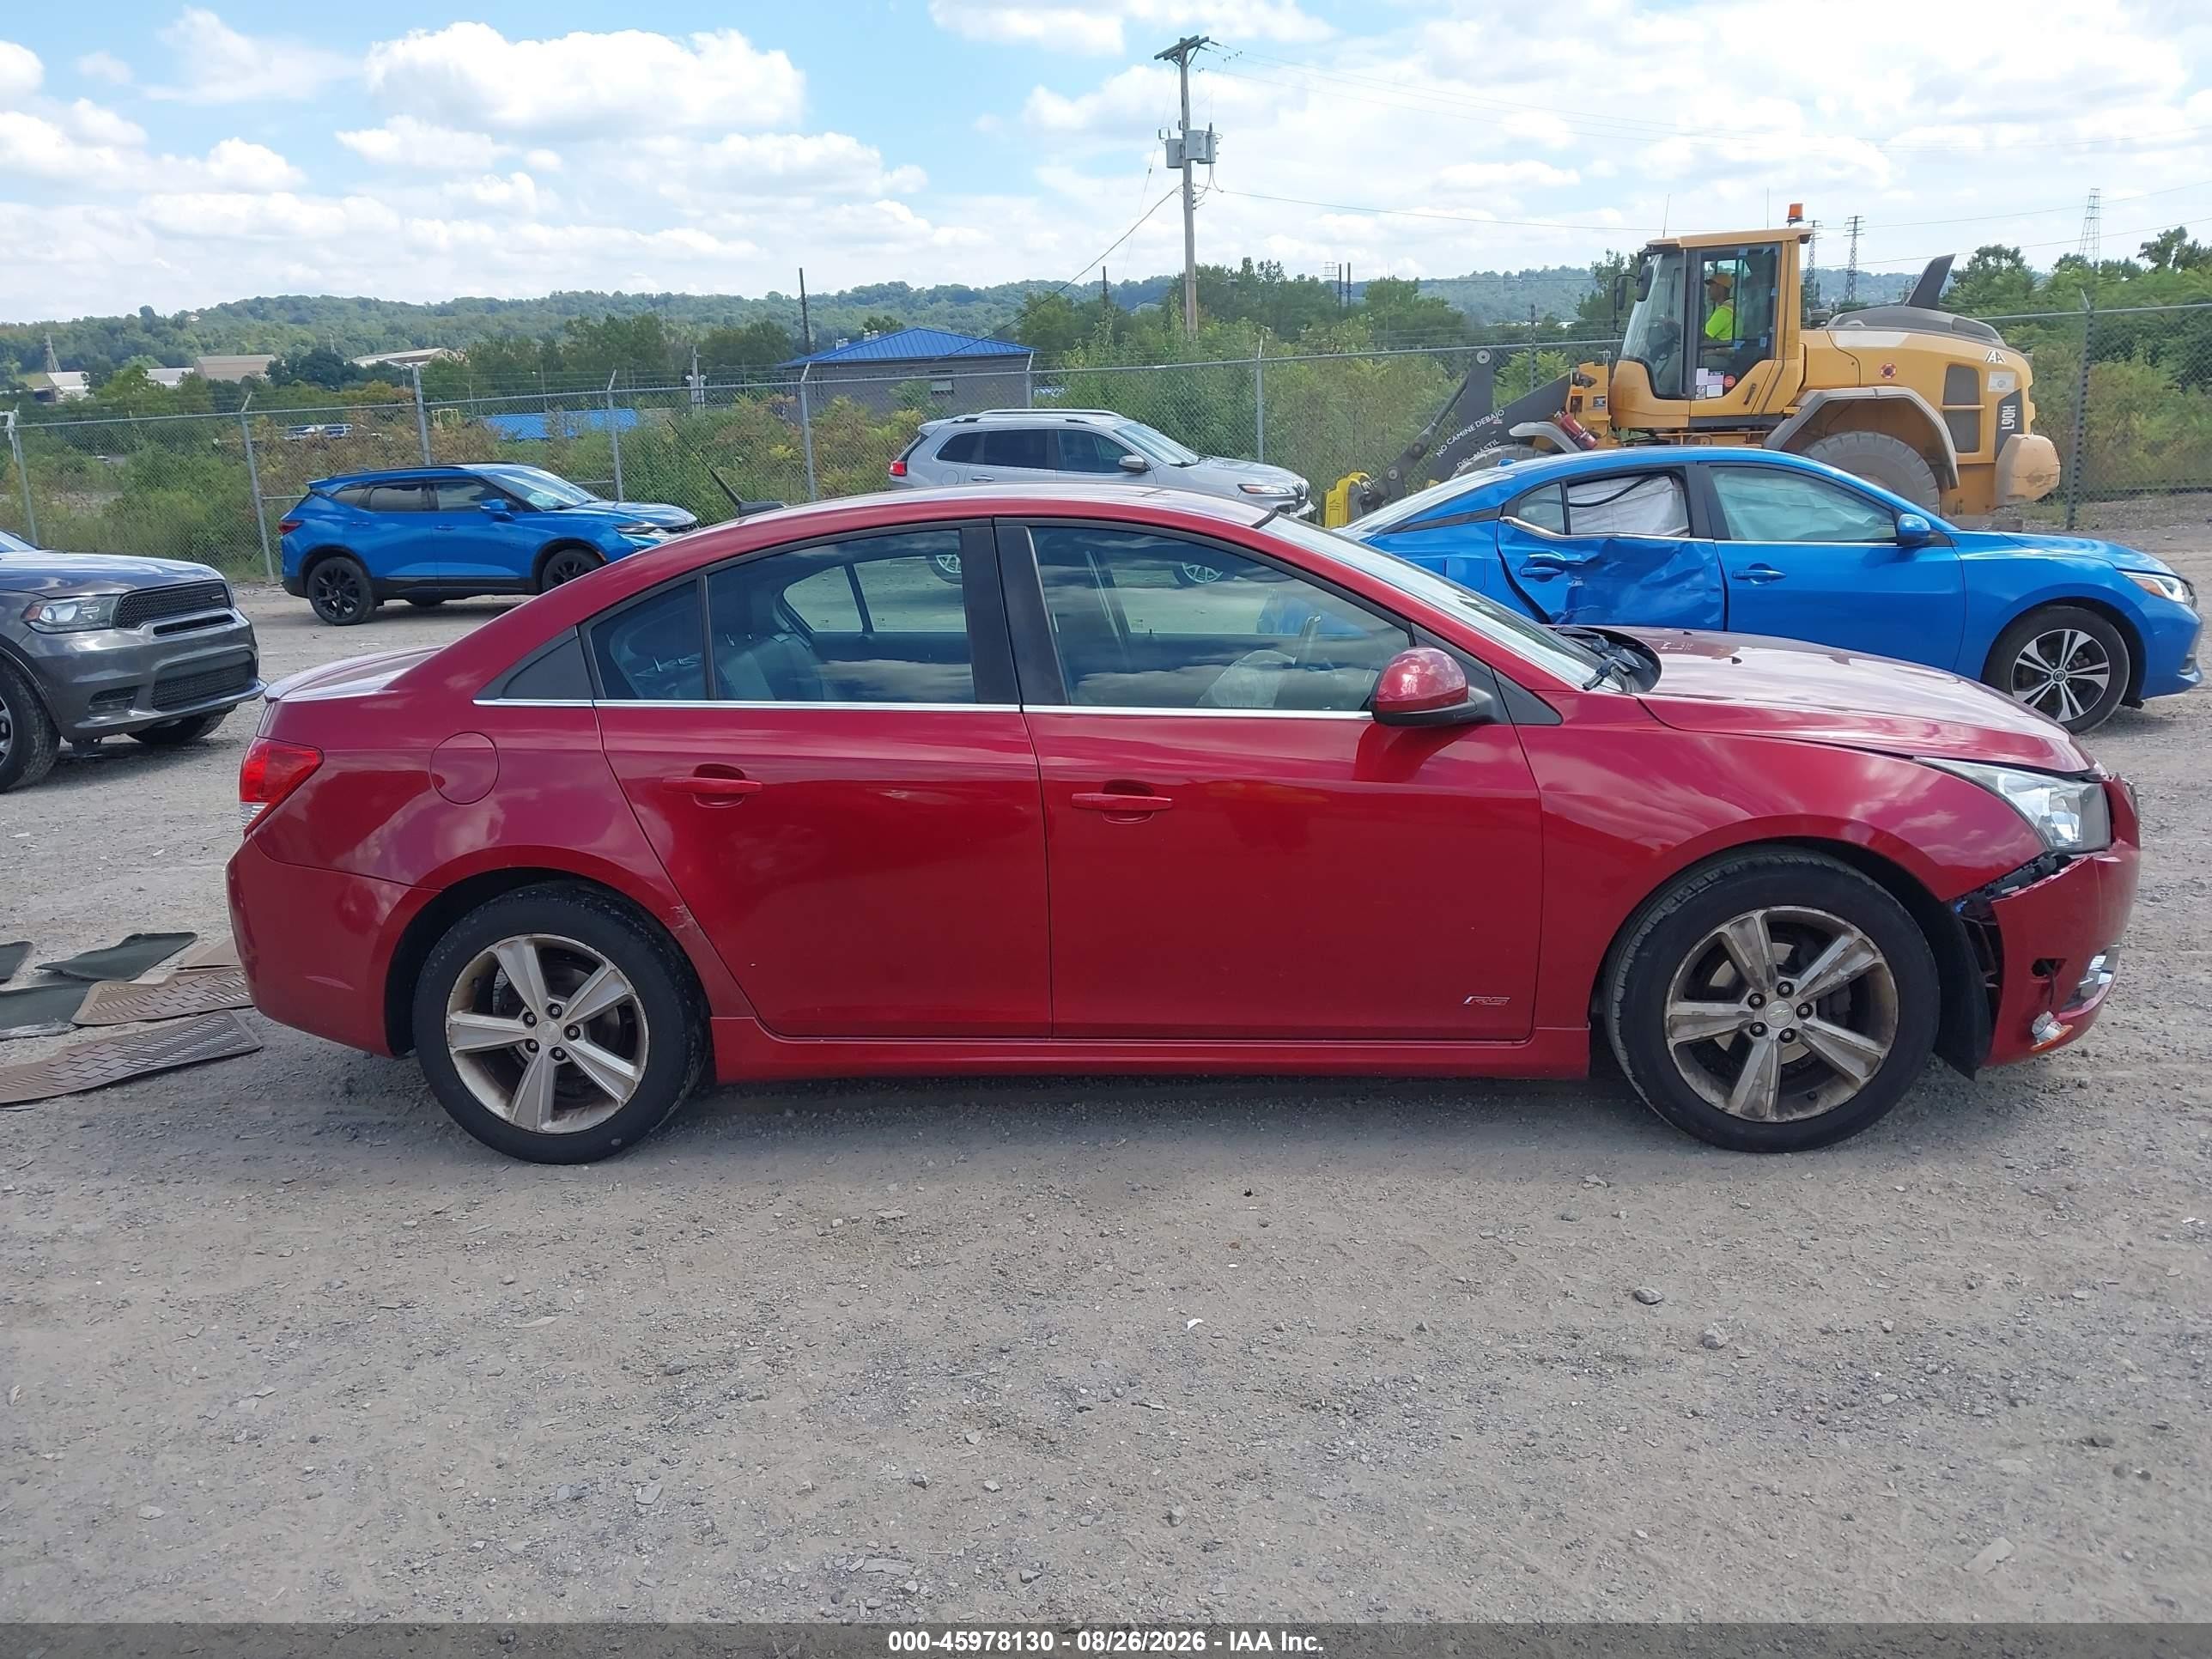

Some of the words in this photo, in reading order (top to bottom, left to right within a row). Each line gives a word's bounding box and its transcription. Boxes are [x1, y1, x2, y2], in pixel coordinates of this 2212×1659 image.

[2001, 404, 2016, 429] L90H
[1436, 444, 1448, 458] NO
[1446, 424, 1476, 445] CAMINE
[1475, 409, 1504, 428] DEBAJO
[1463, 996, 1510, 1006] RS
